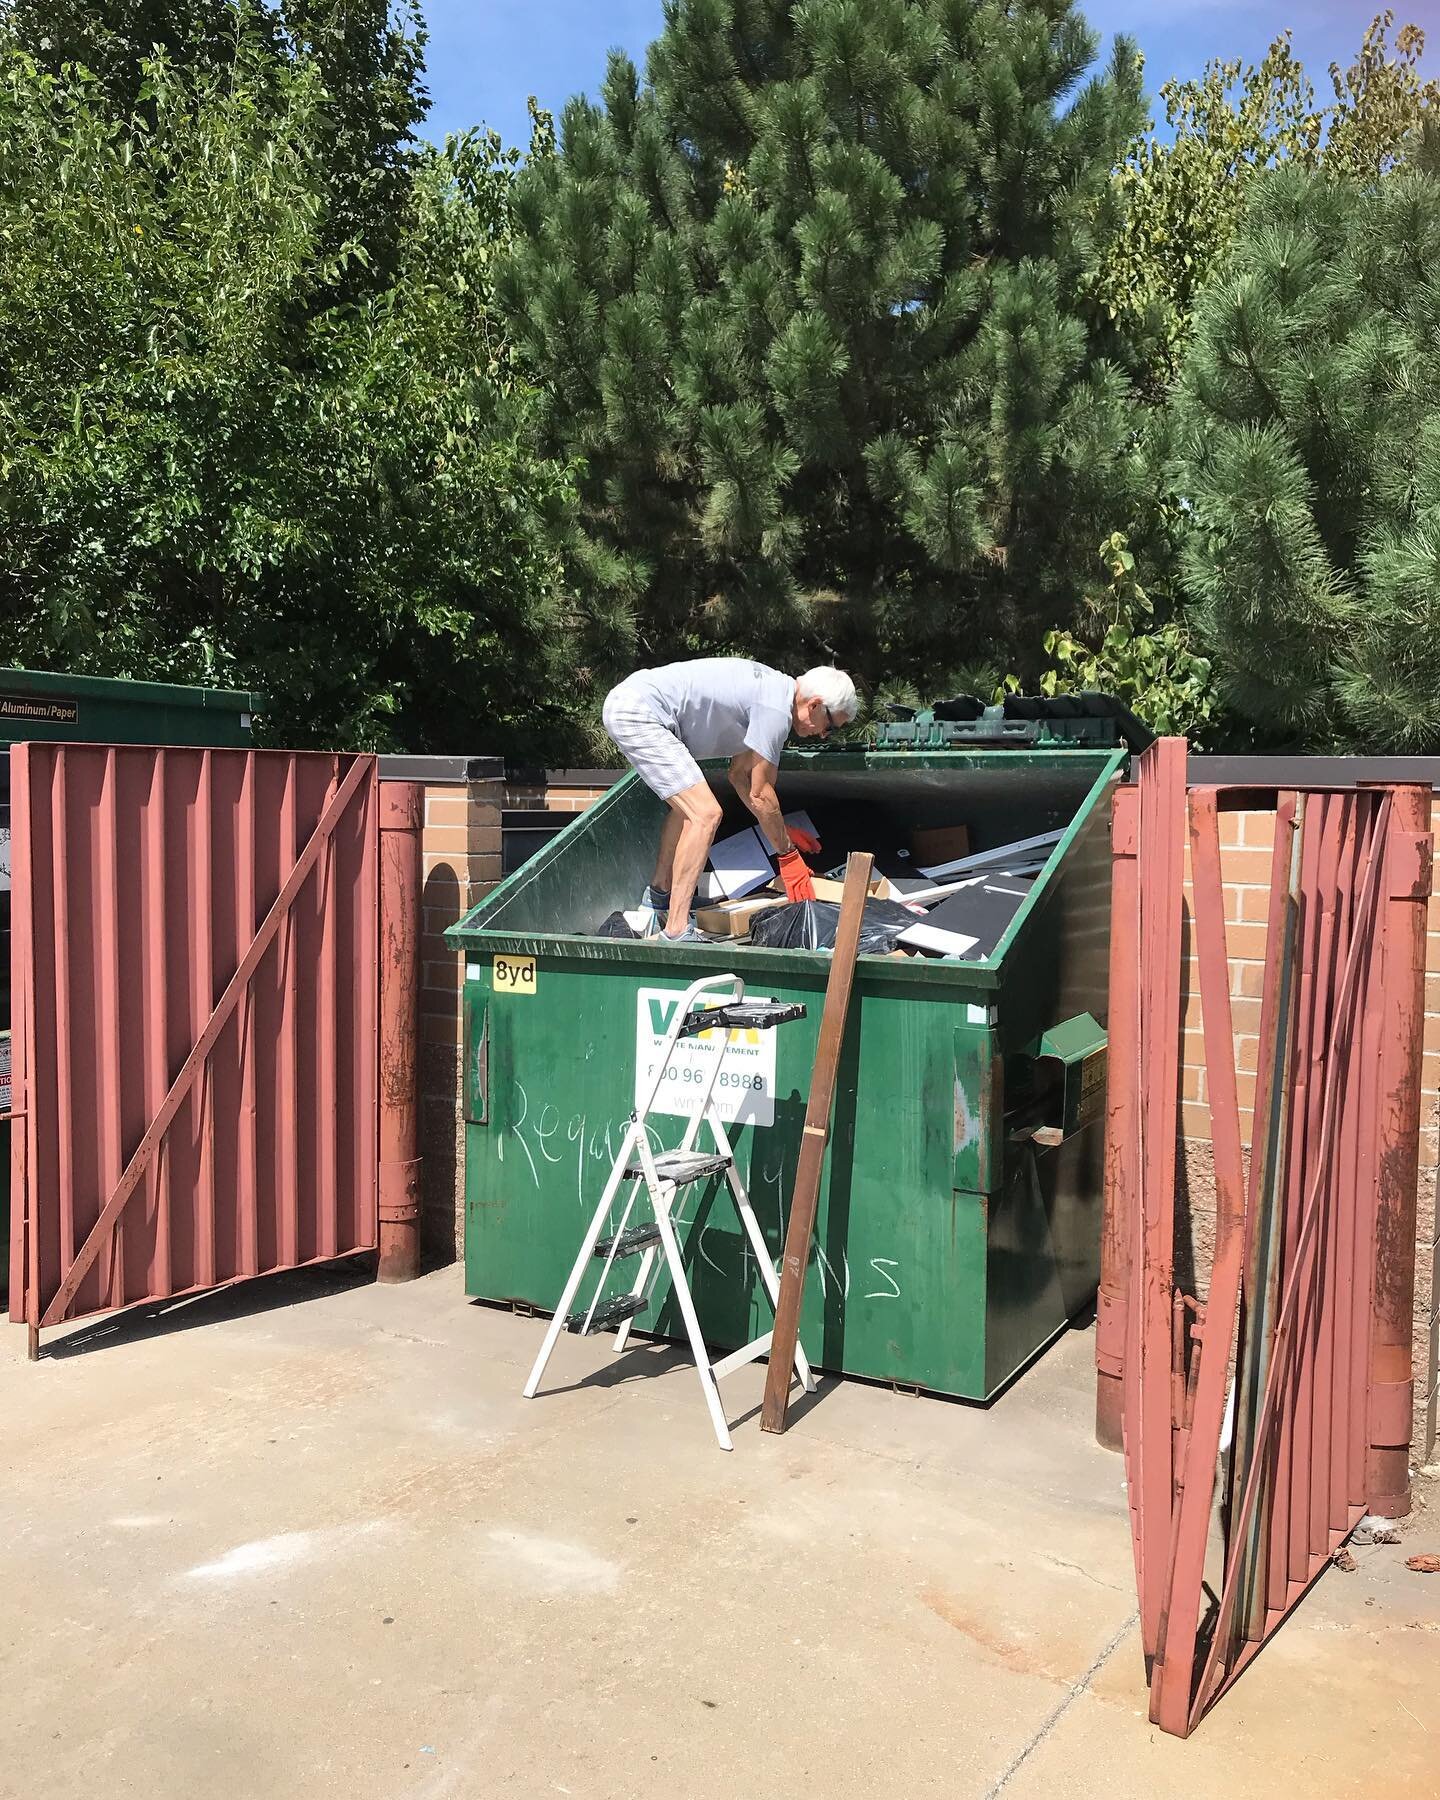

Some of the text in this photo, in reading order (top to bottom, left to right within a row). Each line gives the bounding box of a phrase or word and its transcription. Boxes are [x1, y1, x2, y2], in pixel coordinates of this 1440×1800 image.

[0, 701, 76, 720] Aluminum/Paper
[496, 960, 534, 986] 8yd
[653, 1039, 760, 1056] WTE MANEMENT
[683, 1067, 703, 1084] 96
[719, 1071, 763, 1091] 8988
